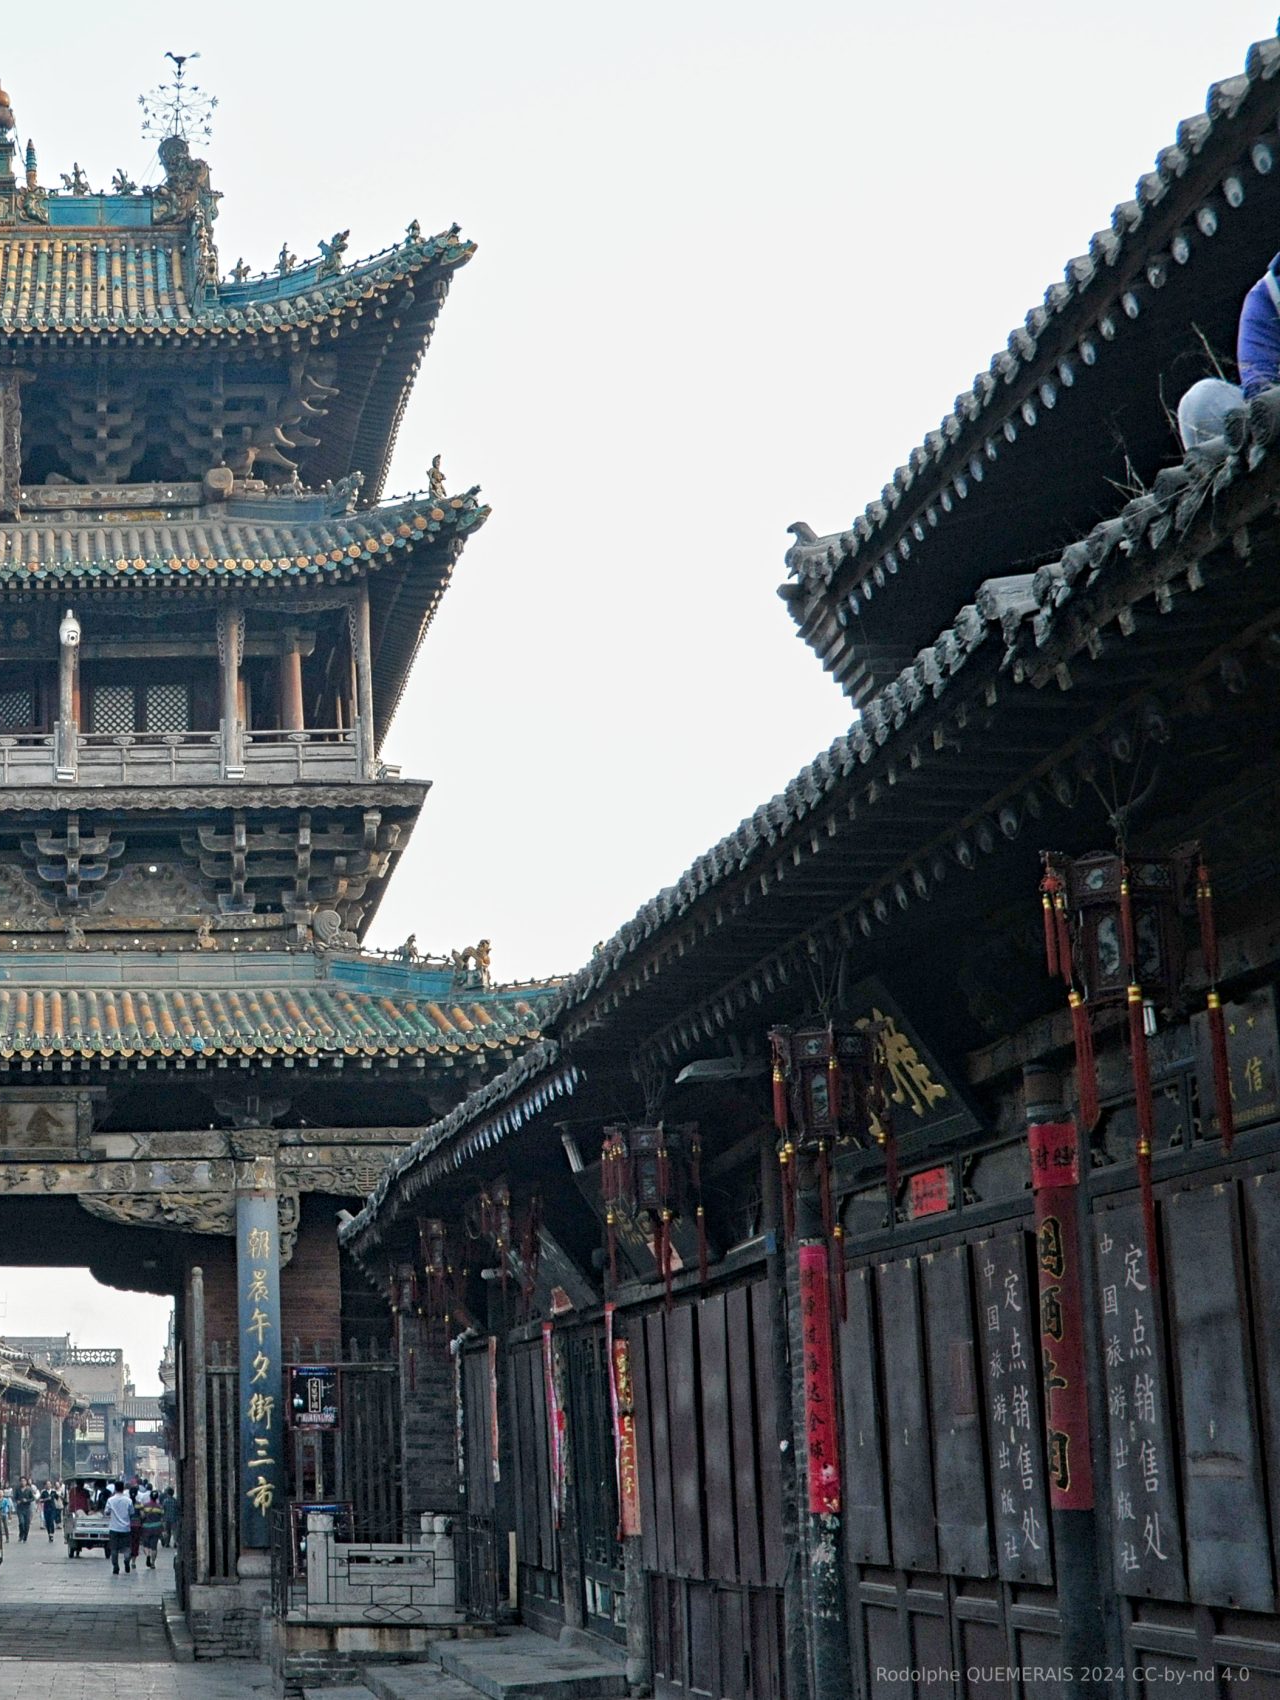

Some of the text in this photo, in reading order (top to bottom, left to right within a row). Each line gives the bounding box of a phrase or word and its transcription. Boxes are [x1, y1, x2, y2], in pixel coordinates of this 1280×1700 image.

[246, 1227, 275, 1518] 朝晨午夕街三市
[983, 1258, 1020, 1561] 中国旅游出版社
[1004, 1269, 1040, 1550] 定点销售处
[1099, 1233, 1141, 1574] 中国旅游出版社
[1124, 1243, 1167, 1561] 定点销售处
